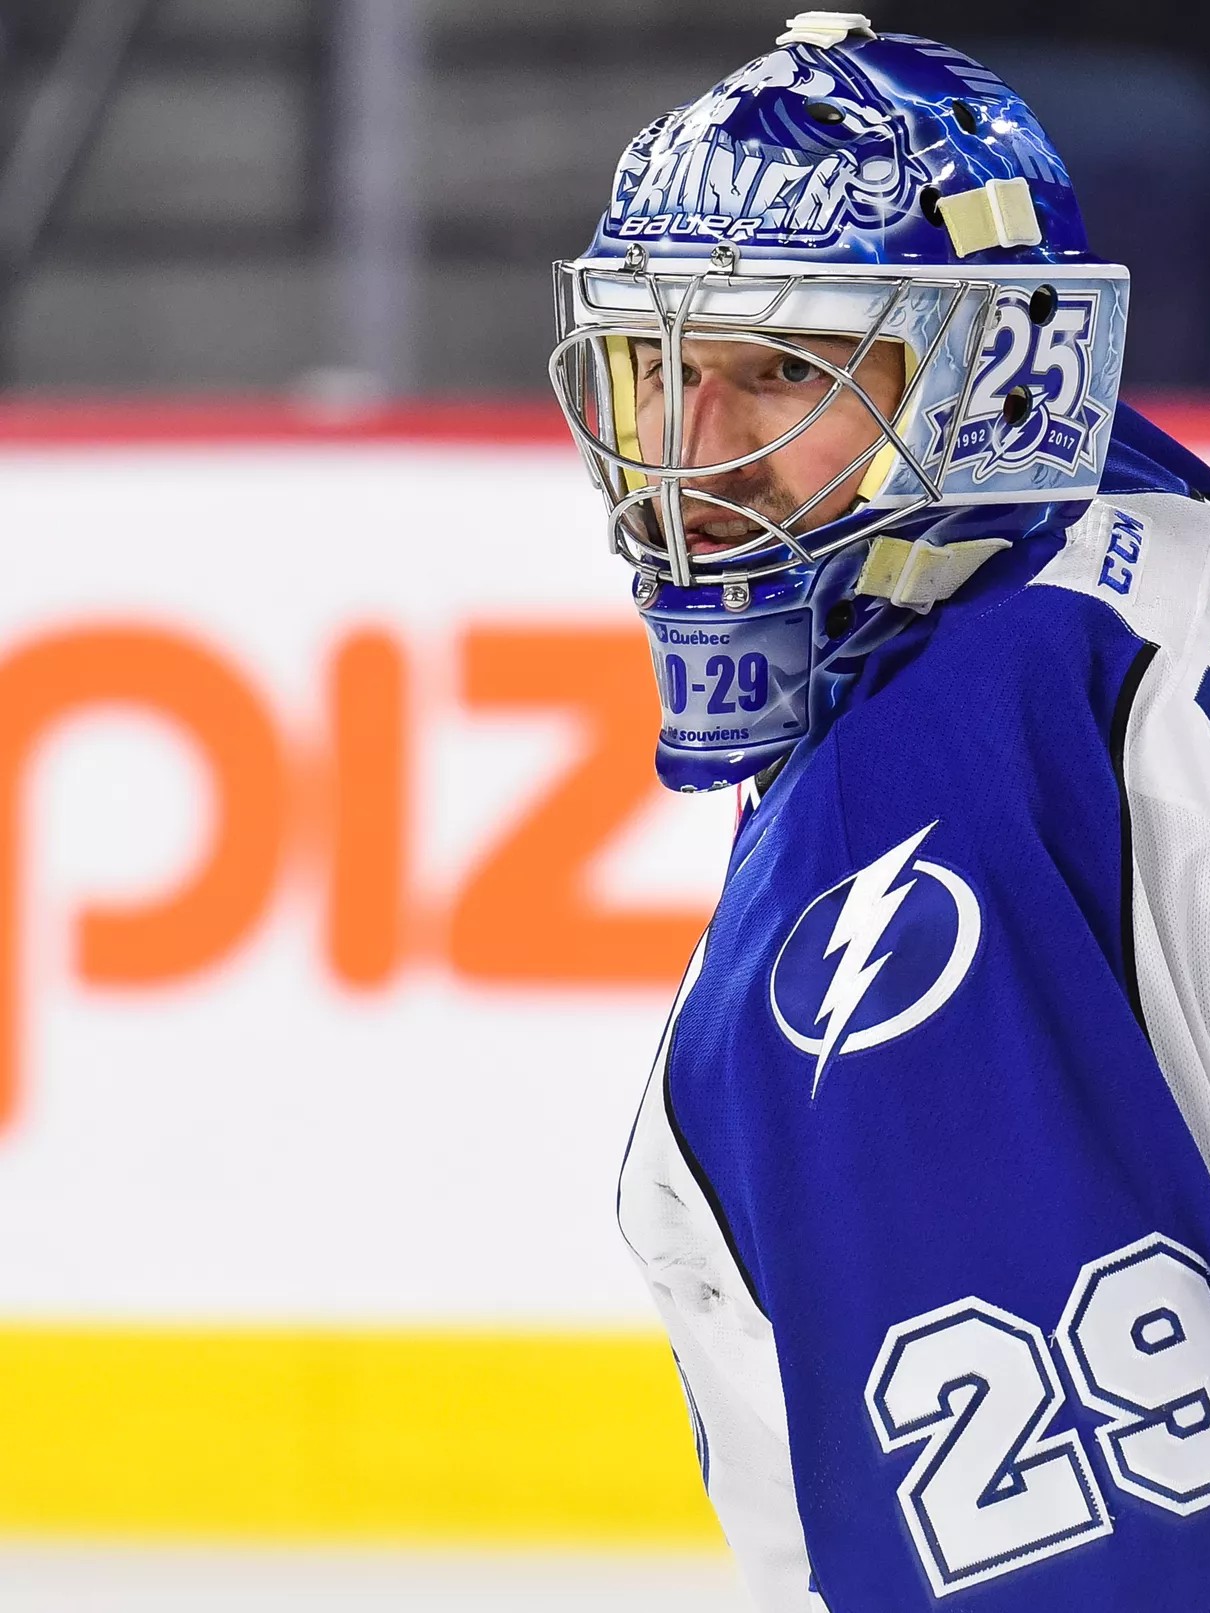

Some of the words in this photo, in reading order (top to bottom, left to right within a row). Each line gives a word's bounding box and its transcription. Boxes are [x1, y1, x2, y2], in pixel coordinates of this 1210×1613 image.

[966, 296, 1088, 418] 25
[956, 429, 986, 449] 1992
[1048, 430, 1075, 449] 2017
[1098, 509, 1145, 595] CCM
[669, 628, 731, 645] Québec
[679, 725, 750, 742] souviens
